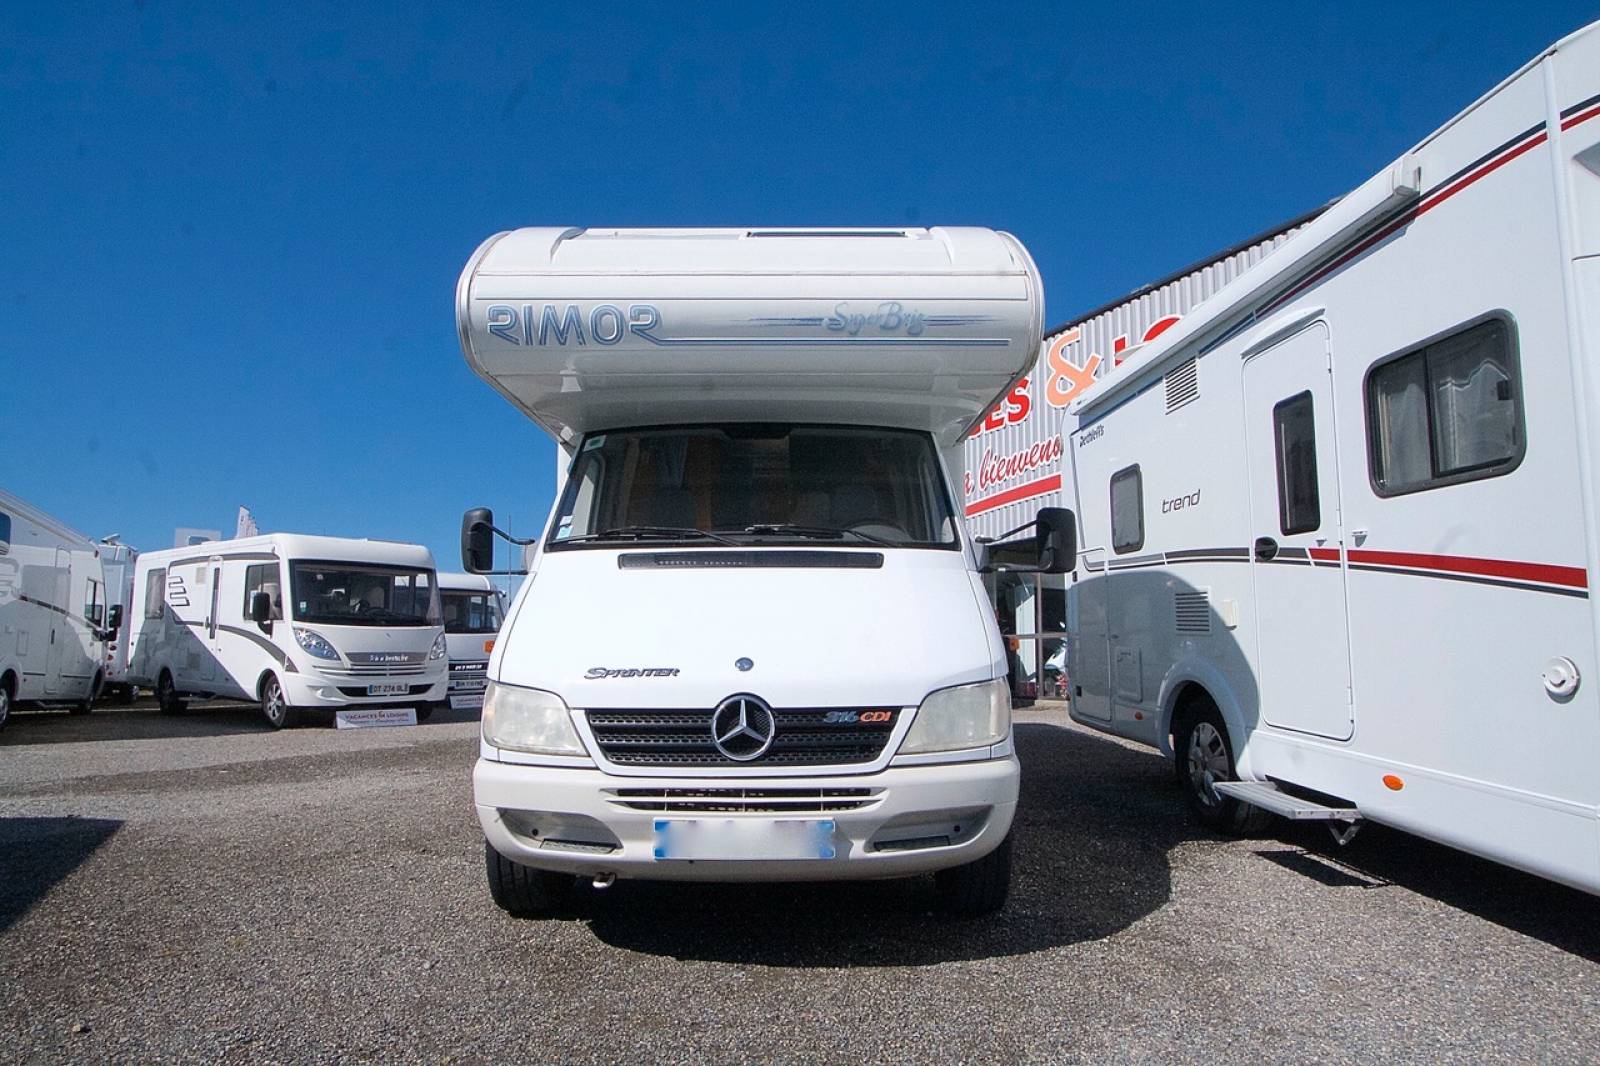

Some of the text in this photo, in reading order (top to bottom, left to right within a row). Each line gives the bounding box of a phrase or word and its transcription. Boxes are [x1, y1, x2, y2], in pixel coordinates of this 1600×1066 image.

[487, 304, 661, 346] RIMOR
[1162, 488, 1201, 514] trend
[860, 710, 892, 722] CDI
